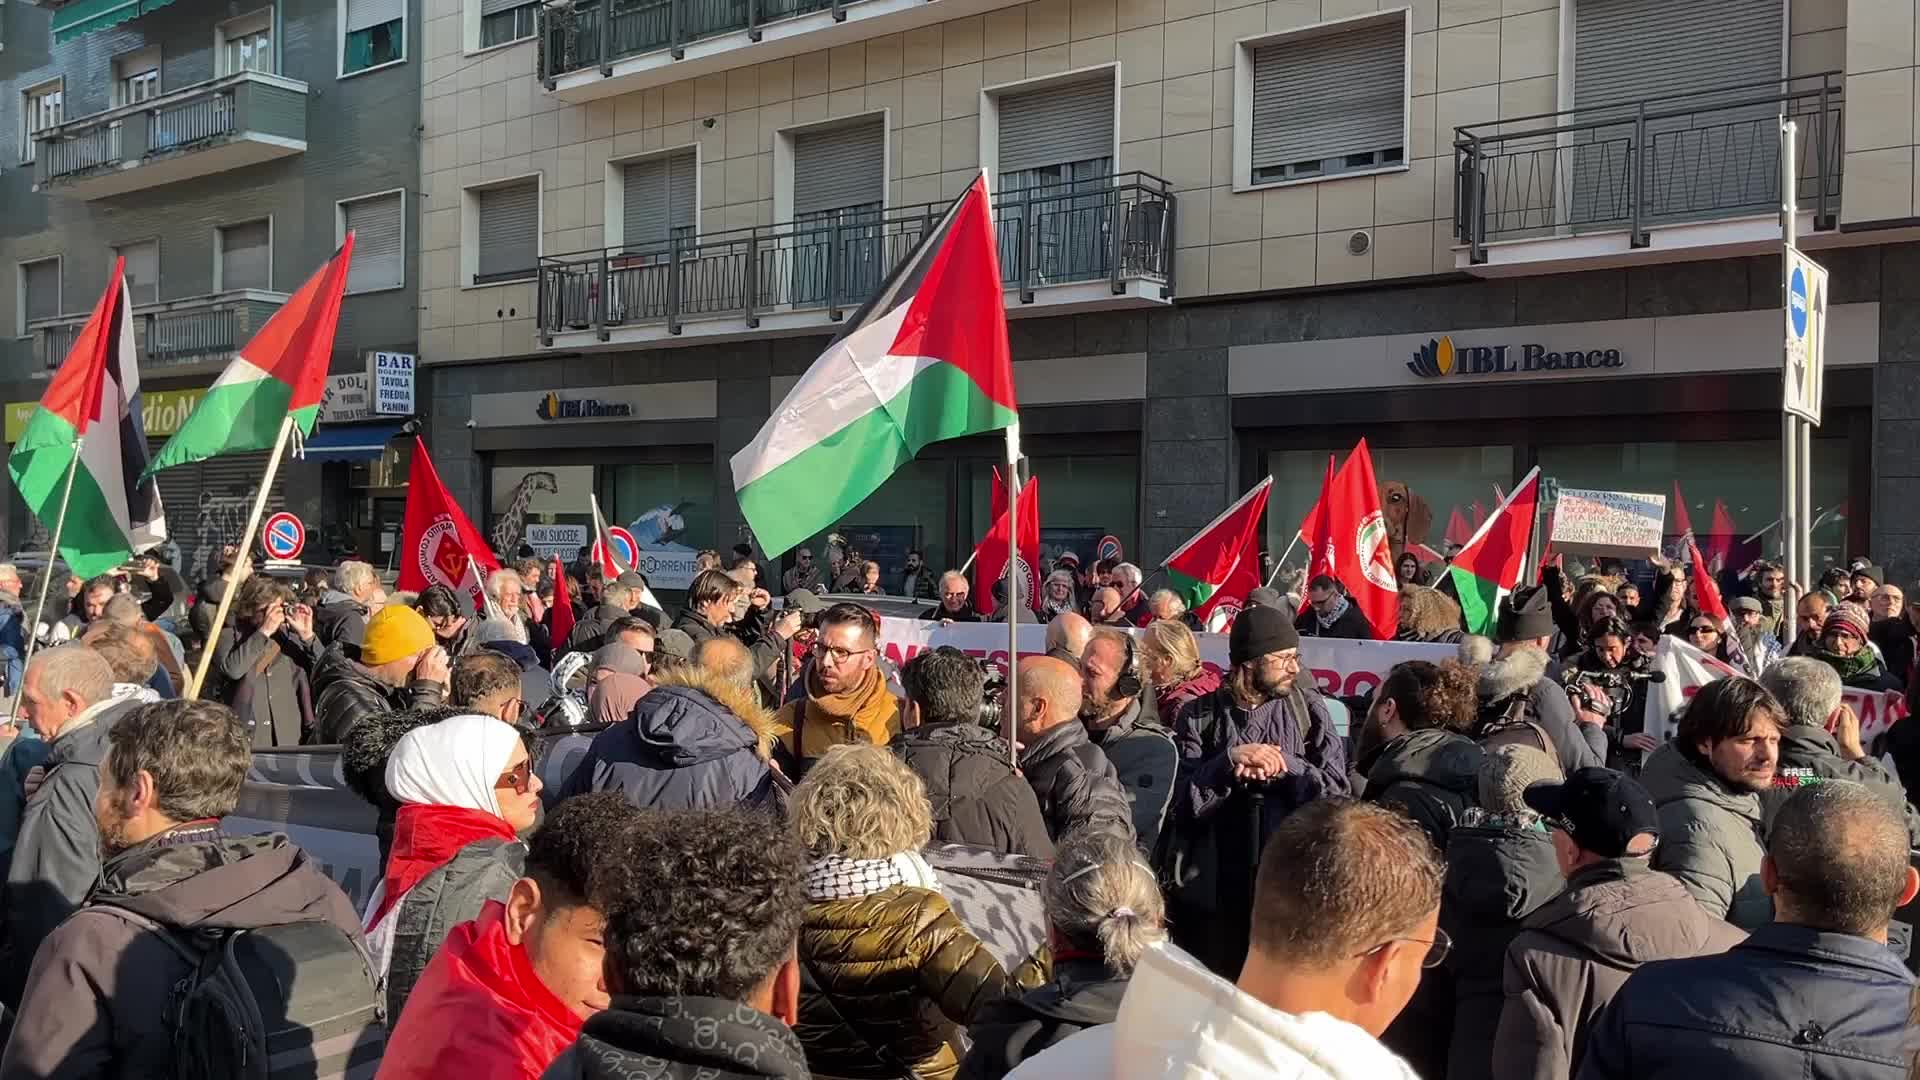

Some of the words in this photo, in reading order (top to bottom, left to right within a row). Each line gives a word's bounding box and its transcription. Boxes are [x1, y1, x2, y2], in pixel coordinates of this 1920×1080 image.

[378, 355, 412, 369] BAR
[1455, 345, 1518, 374] IBL
[1521, 344, 1624, 371] Banca
[380, 376, 409, 387] TAVOLA
[380, 389, 410, 400] FREDDA
[382, 402, 409, 413] PANINI
[1025, 572, 1035, 610] COMUNIS
[1784, 768, 1814, 777] FREE
